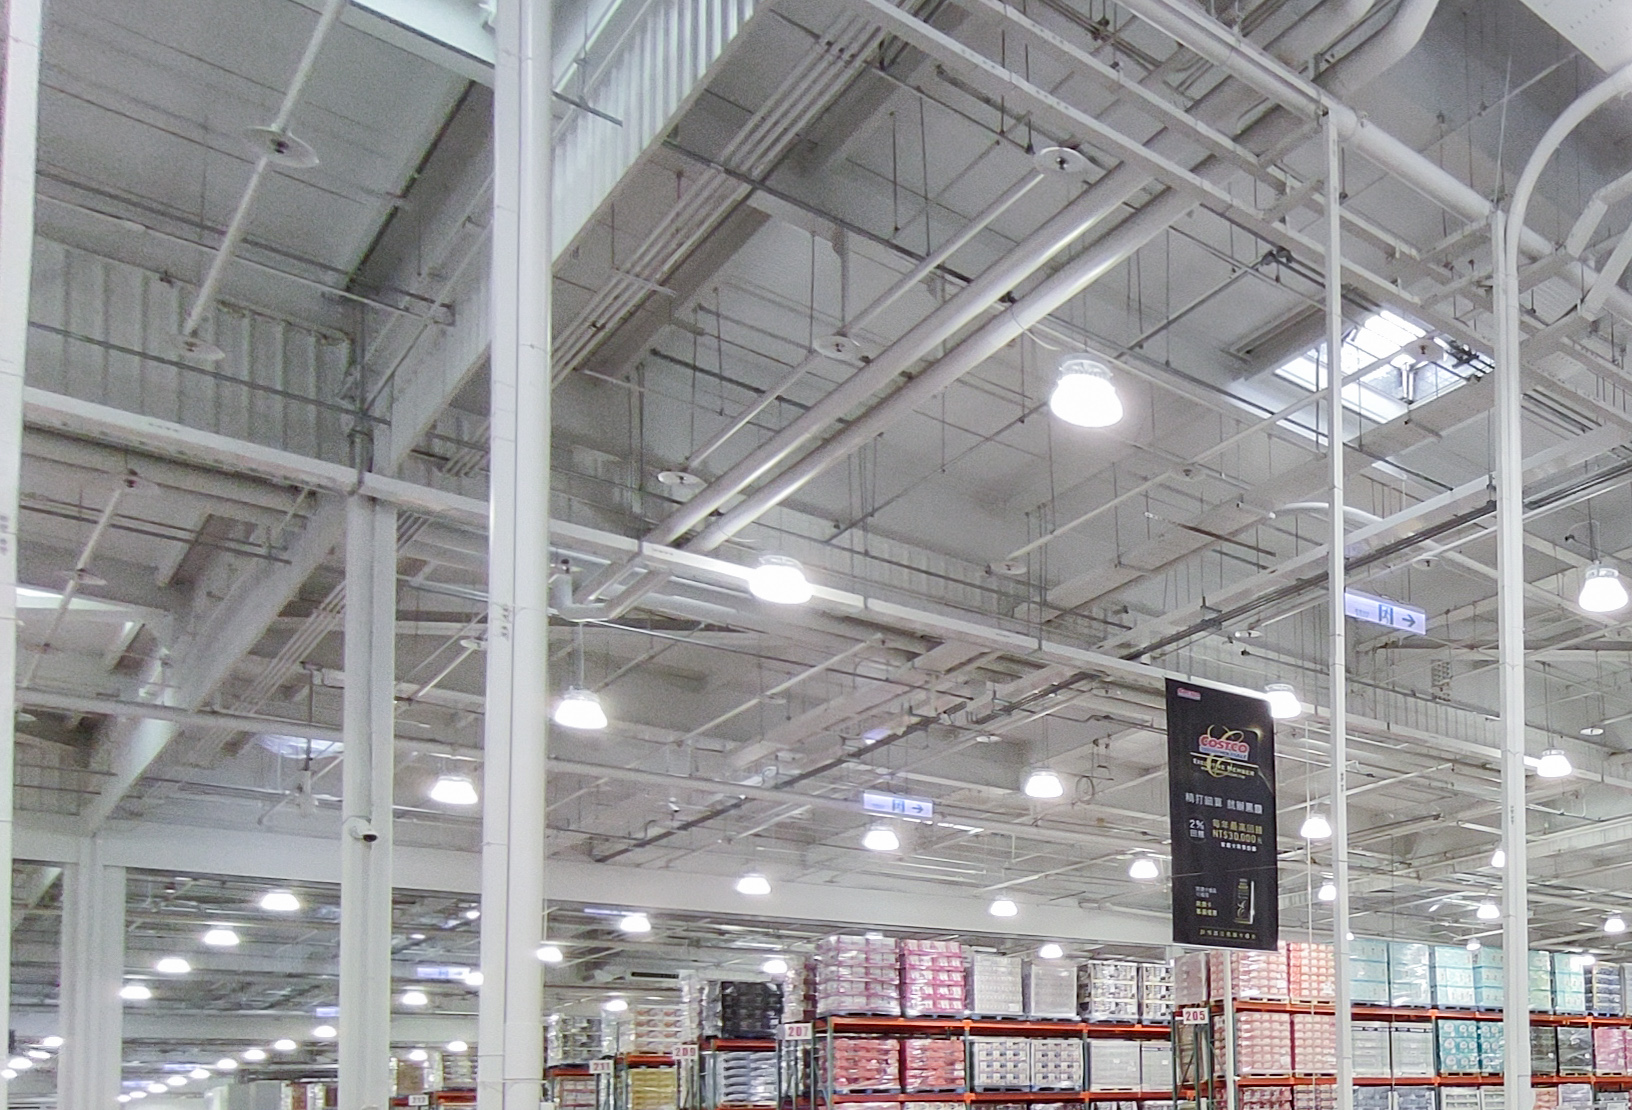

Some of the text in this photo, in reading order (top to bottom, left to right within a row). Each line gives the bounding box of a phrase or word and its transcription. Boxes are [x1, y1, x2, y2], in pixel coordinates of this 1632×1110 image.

[1200, 735, 1249, 753] COSTCO
[1185, 1010, 1206, 1021] 205
[788, 1025, 809, 1037] 207
